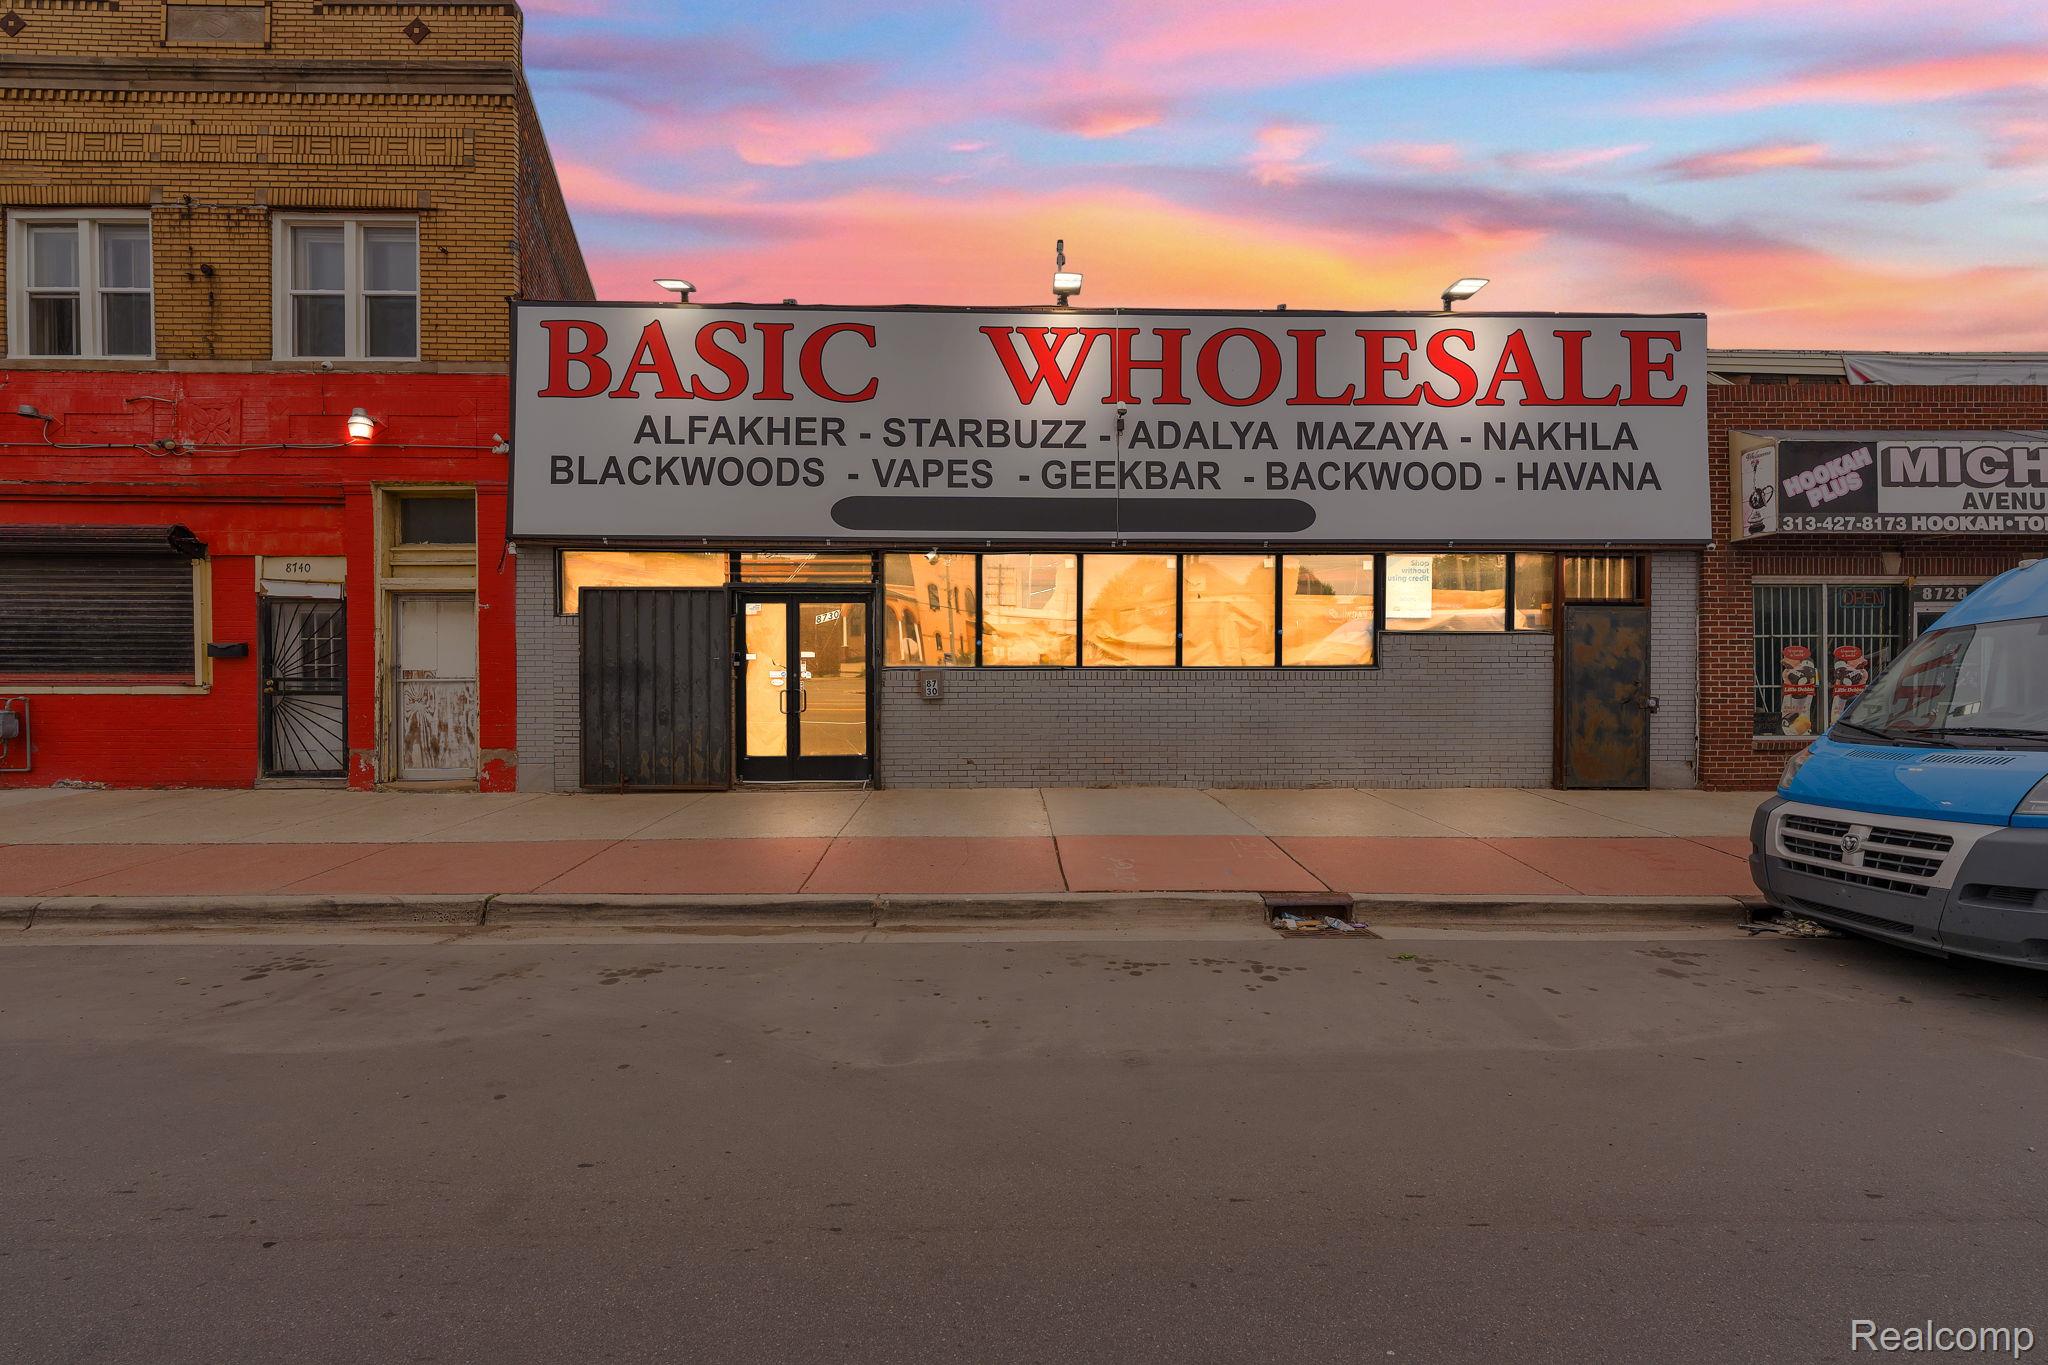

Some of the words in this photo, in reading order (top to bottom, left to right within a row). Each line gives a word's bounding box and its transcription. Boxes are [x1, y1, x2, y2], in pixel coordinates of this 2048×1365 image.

[538, 319, 878, 403] BASIC
[979, 325, 1688, 408] WHOLESALE
[633, 415, 847, 446] ALFAKHER
[882, 418, 1087, 447] STARBUZZ
[1129, 421, 1279, 450] ADALYA
[1296, 421, 1449, 450] MAZAYA
[1483, 421, 1639, 450] NAKHLA
[550, 455, 825, 487] BLACKWOODS
[871, 459, 994, 489] VAPES
[1041, 460, 1222, 490] GEEKBAR
[1266, 461, 1482, 491] BACKWOOD
[1517, 461, 1663, 490] HAVANA
[1782, 446, 1873, 498] HOOKAH
[1805, 471, 1863, 508] PLUS
[1782, 516, 1907, 531] 313-427-8173
[2014, 516, 2048, 532] TO
[285, 562, 311, 573] 8740
[1410, 560, 1430, 568] Shop
[1843, 589, 1884, 604] OPEN
[1922, 587, 1968, 600] 8728
[816, 610, 839, 623] 8730
